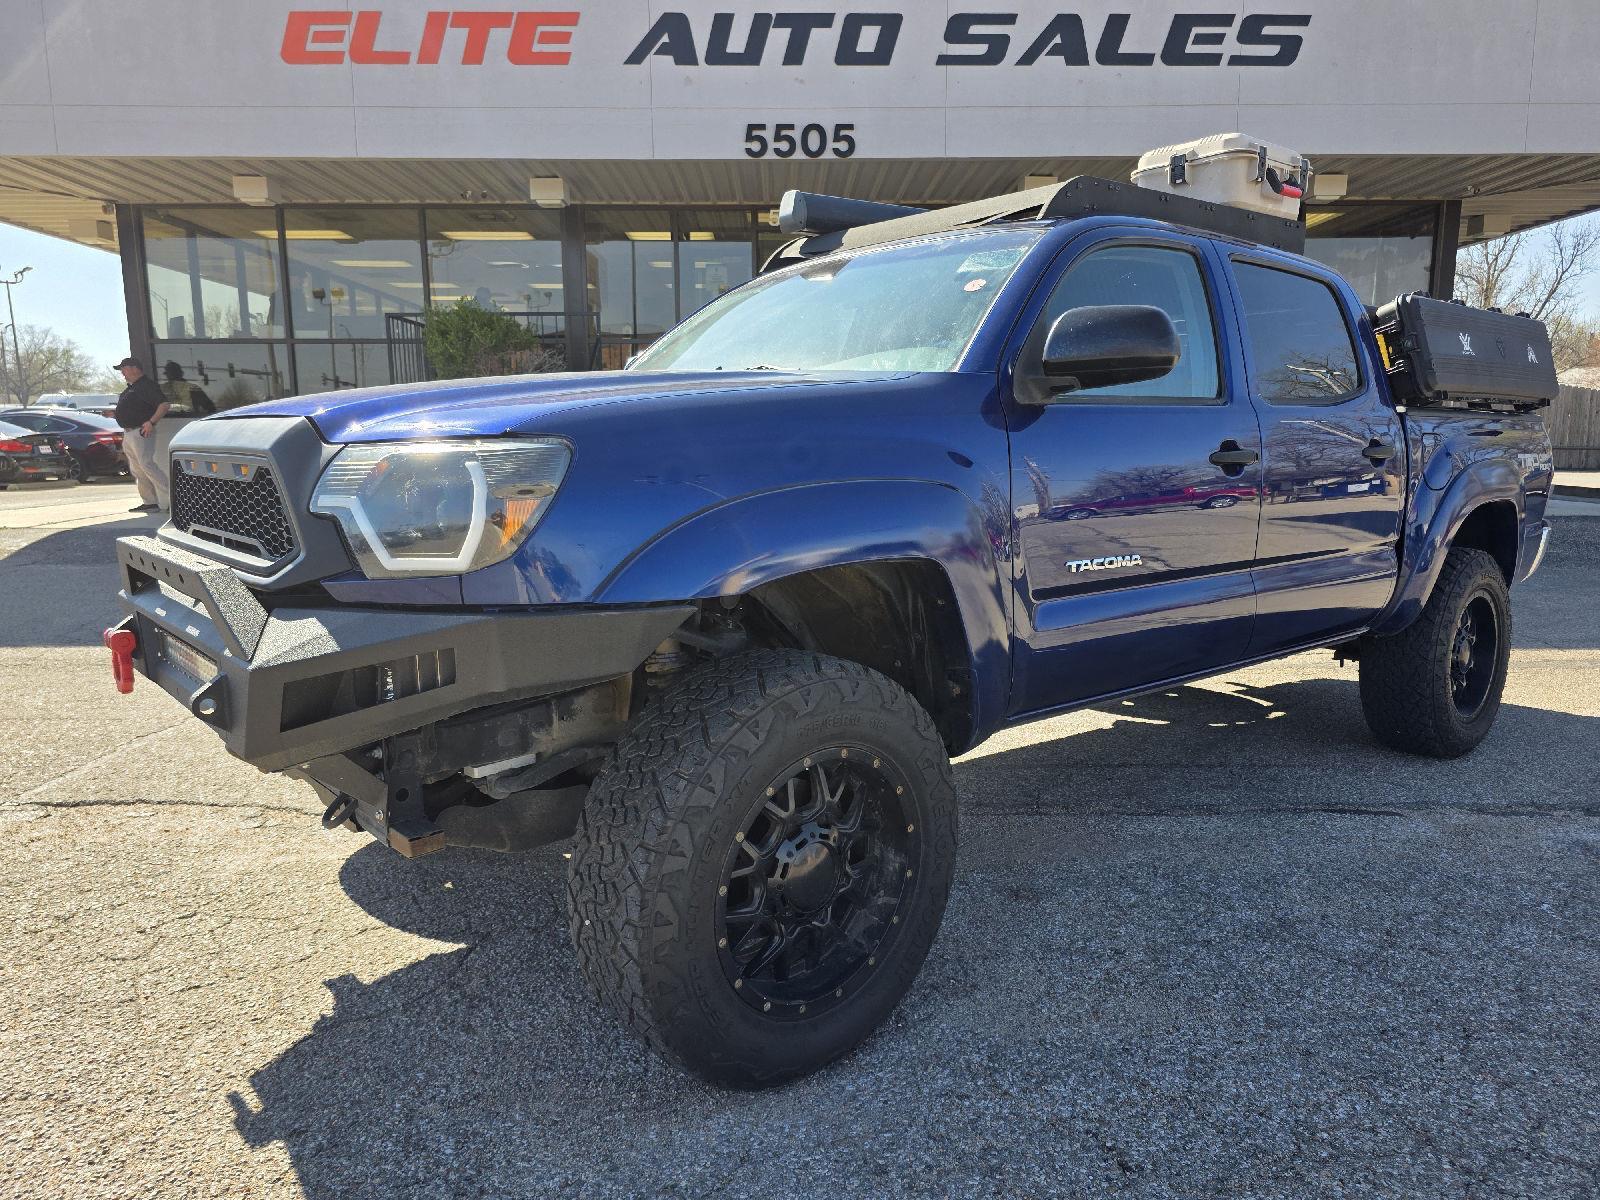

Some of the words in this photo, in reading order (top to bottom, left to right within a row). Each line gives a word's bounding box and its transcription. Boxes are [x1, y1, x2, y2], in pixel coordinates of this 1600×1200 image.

[281, 11, 580, 65] ELITE
[623, 13, 904, 66] AUTO
[936, 13, 1312, 66] SALES
[744, 123, 856, 158] 5505
[1064, 554, 1143, 573] TACOMA
